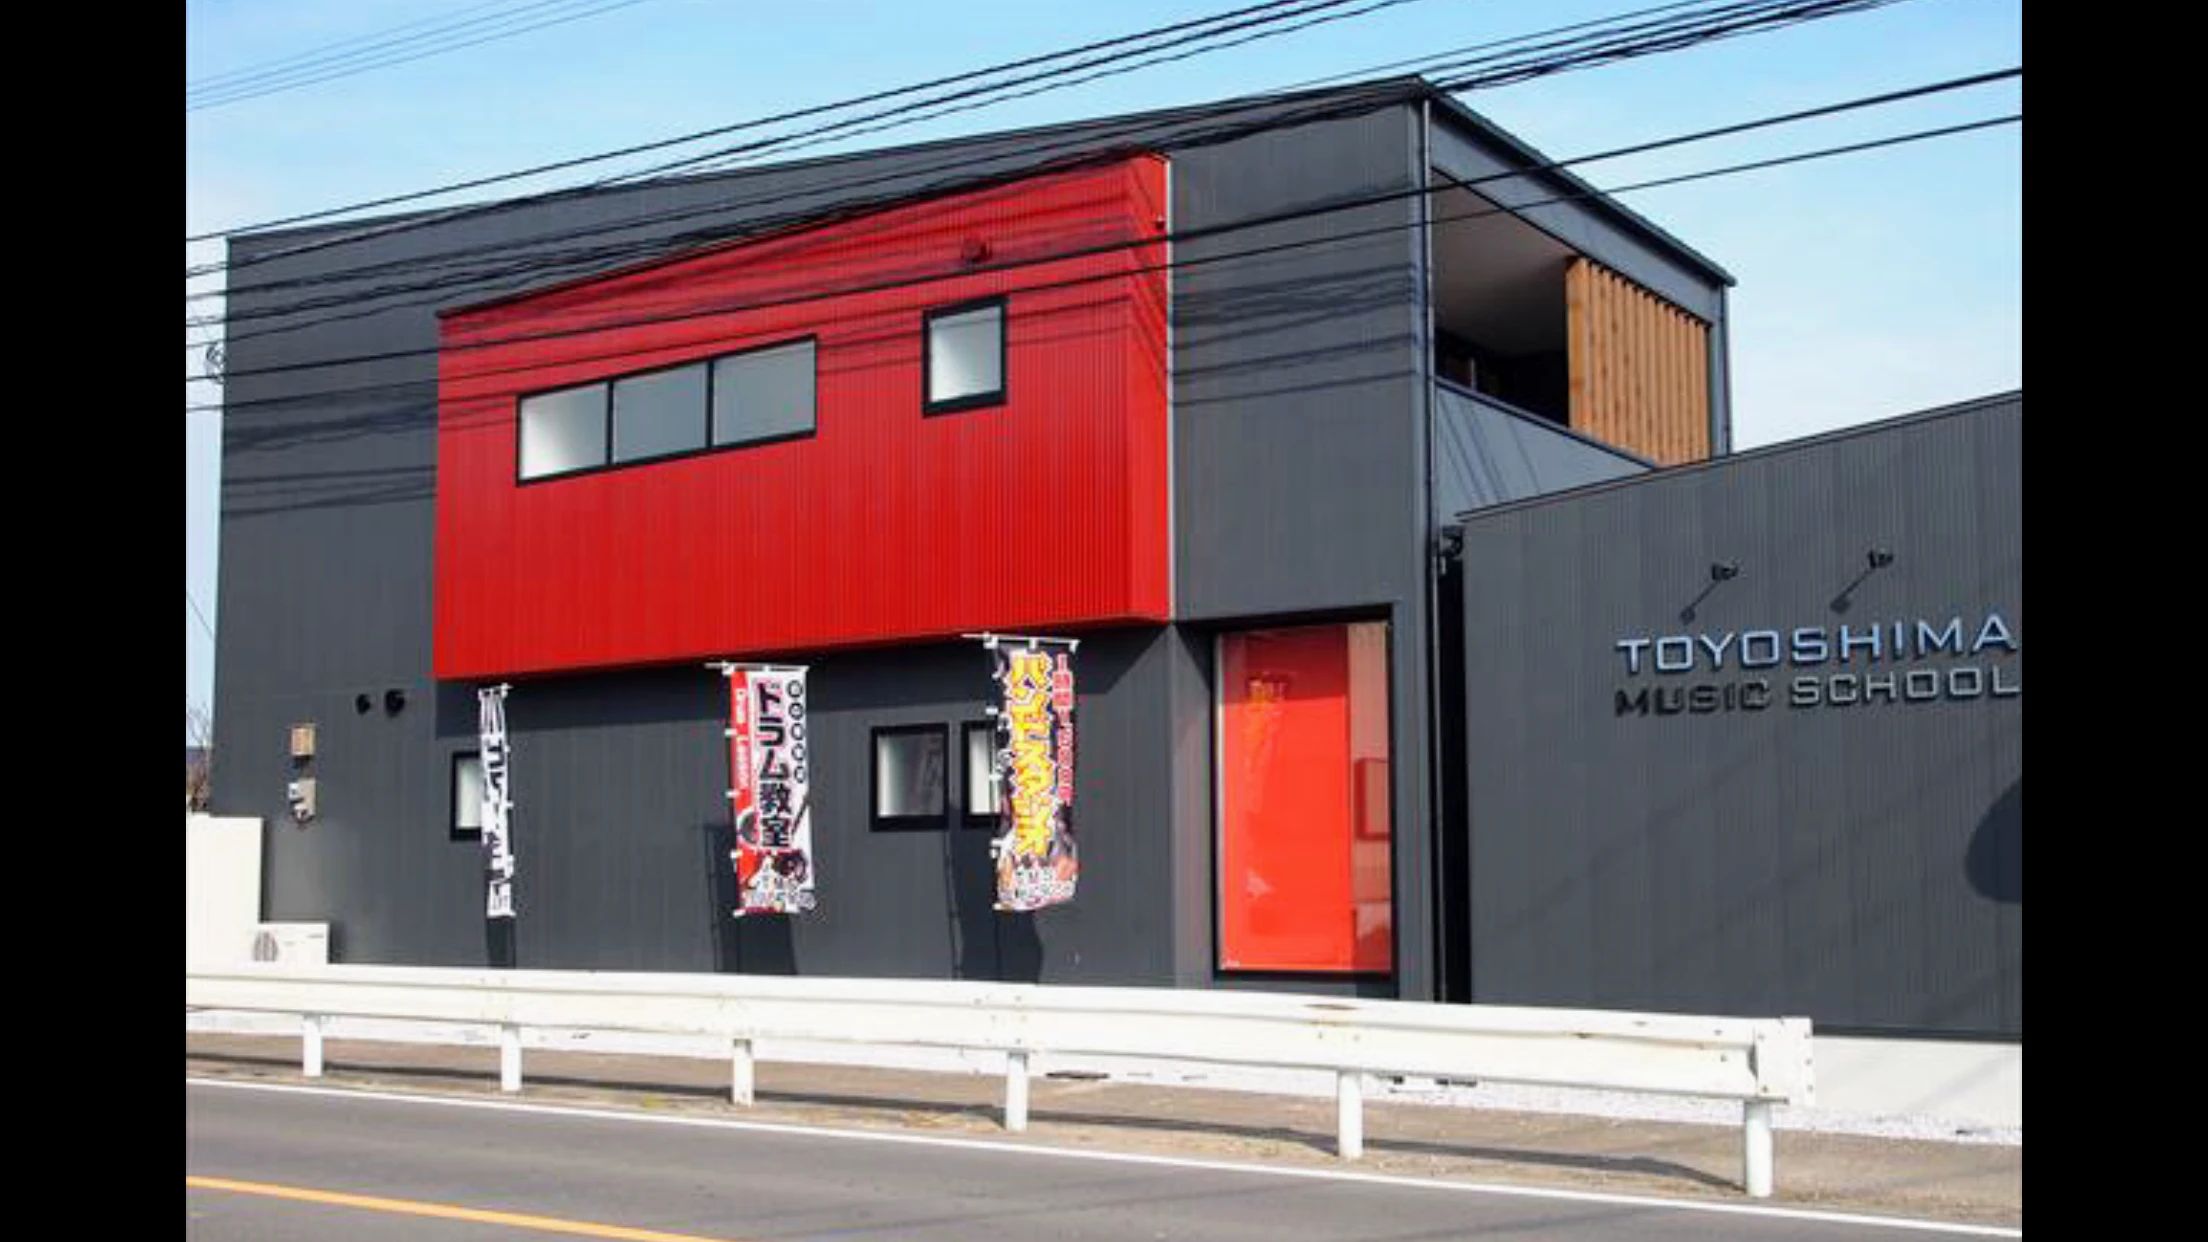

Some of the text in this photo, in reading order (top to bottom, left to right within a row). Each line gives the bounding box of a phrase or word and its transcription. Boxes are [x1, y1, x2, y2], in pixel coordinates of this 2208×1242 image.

[1616, 612, 2019, 675] TOYOSHIMA
[1614, 665, 2021, 718] MUSIC SCHOOL
[757, 681, 791, 847] ドラム教室
